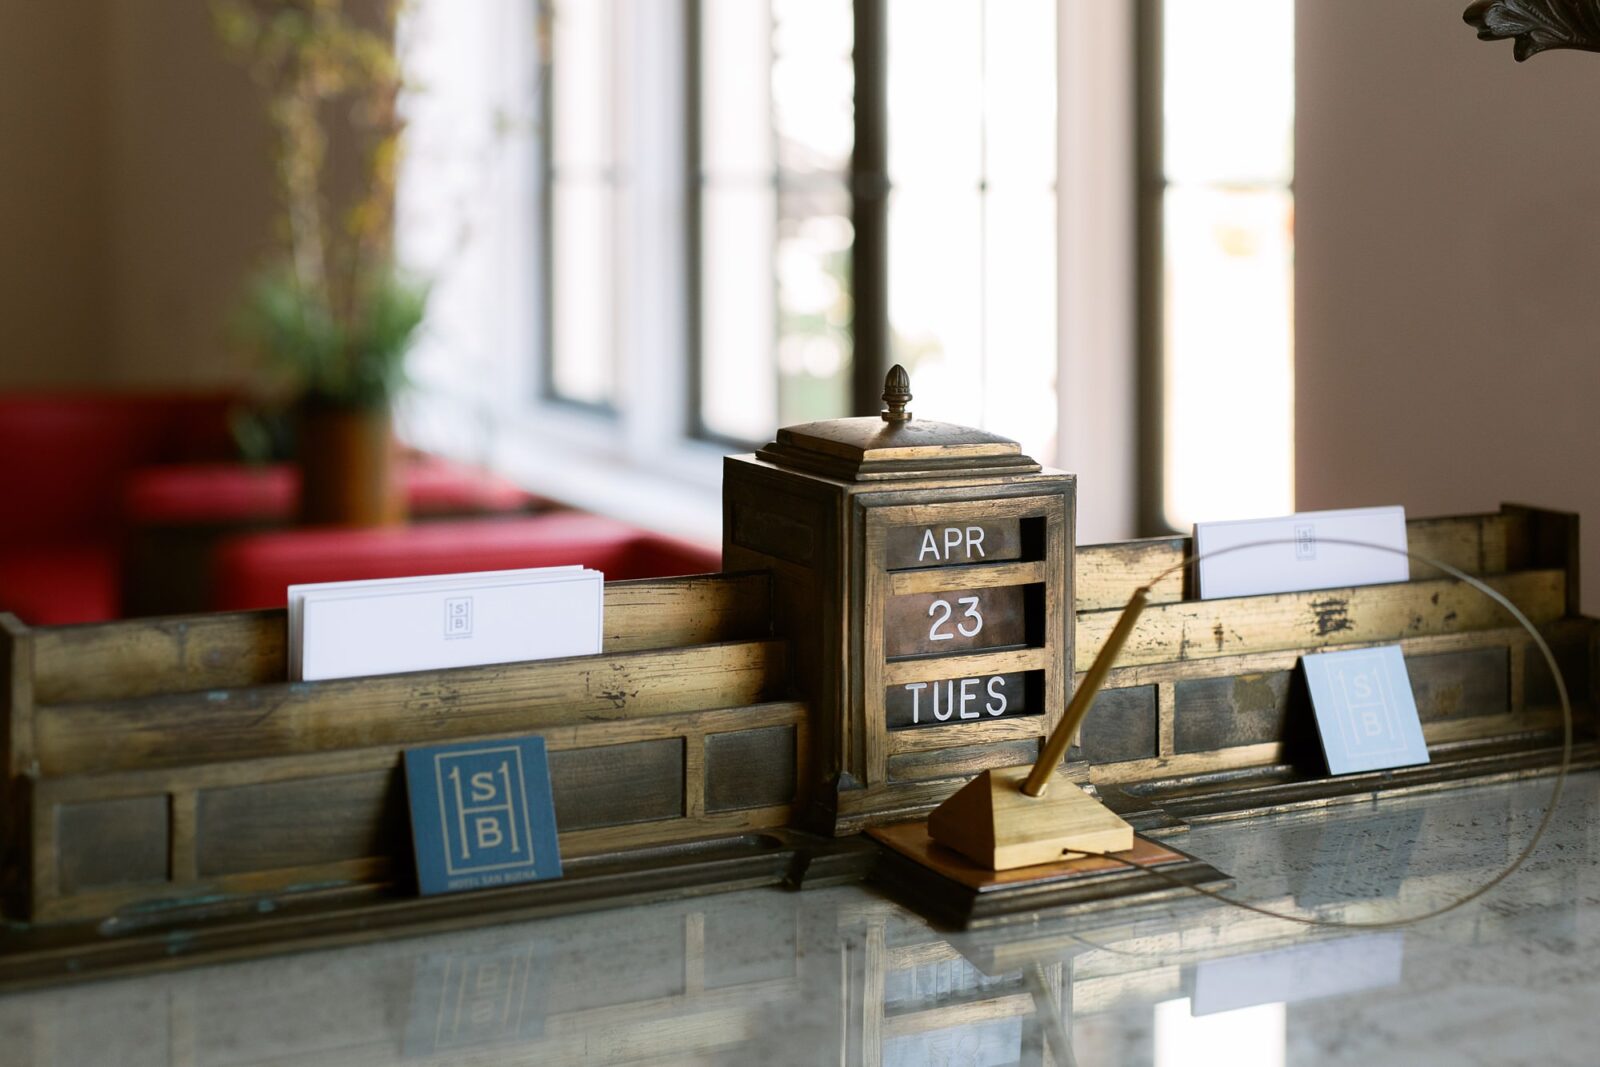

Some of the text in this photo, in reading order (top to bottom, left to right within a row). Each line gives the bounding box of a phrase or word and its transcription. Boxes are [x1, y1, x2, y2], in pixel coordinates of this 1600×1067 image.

[918, 526, 985, 561] APR
[928, 596, 983, 641] 23
[905, 675, 1008, 723] TUES
[1353, 673, 1372, 698] S
[1360, 711, 1383, 737] B
[470, 771, 497, 802] S
[475, 817, 504, 849] B
